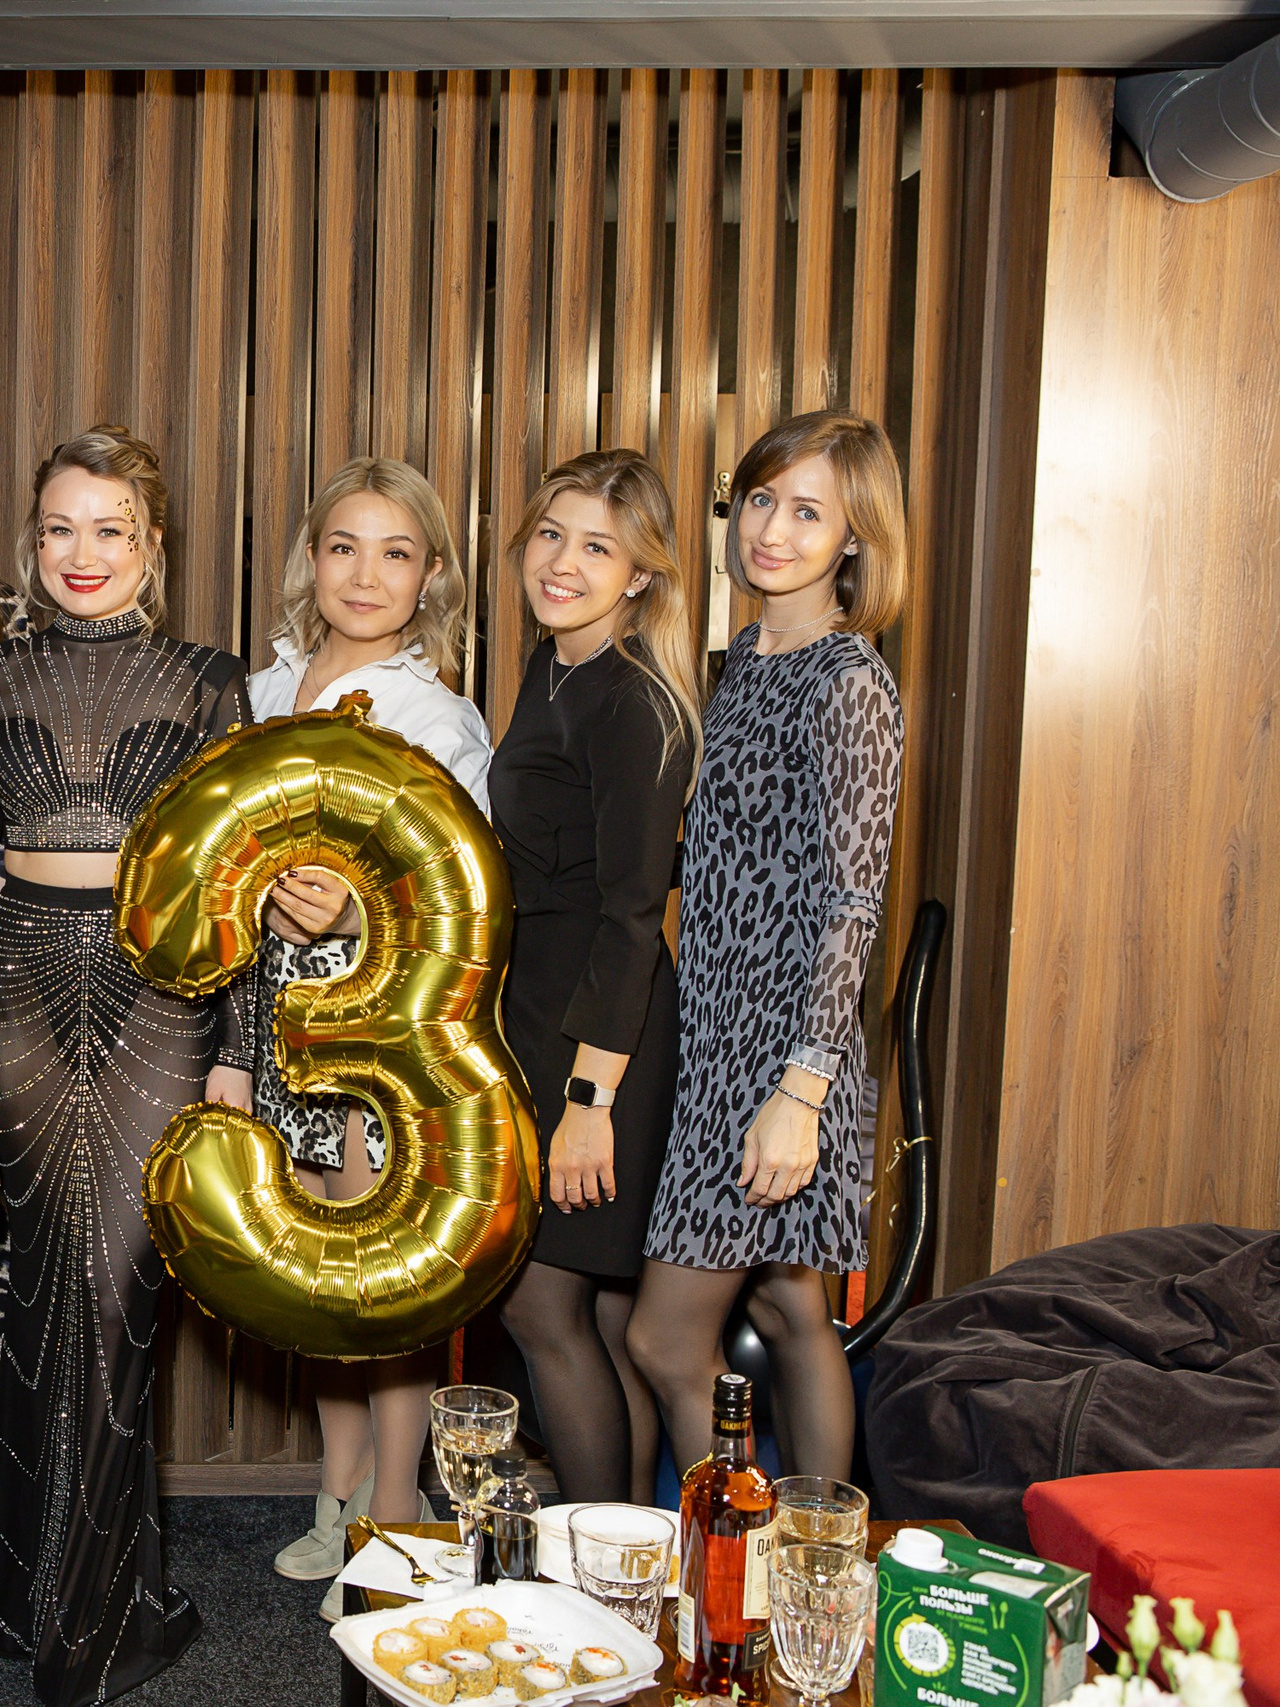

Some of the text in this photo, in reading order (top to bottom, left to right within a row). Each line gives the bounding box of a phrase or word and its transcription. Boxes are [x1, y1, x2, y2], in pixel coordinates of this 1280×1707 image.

[113, 700, 540, 1362] 3
[919, 1594, 974, 1615] ПОЛЬЗЫ
[929, 1584, 990, 1606] БОЛЬШЕ
